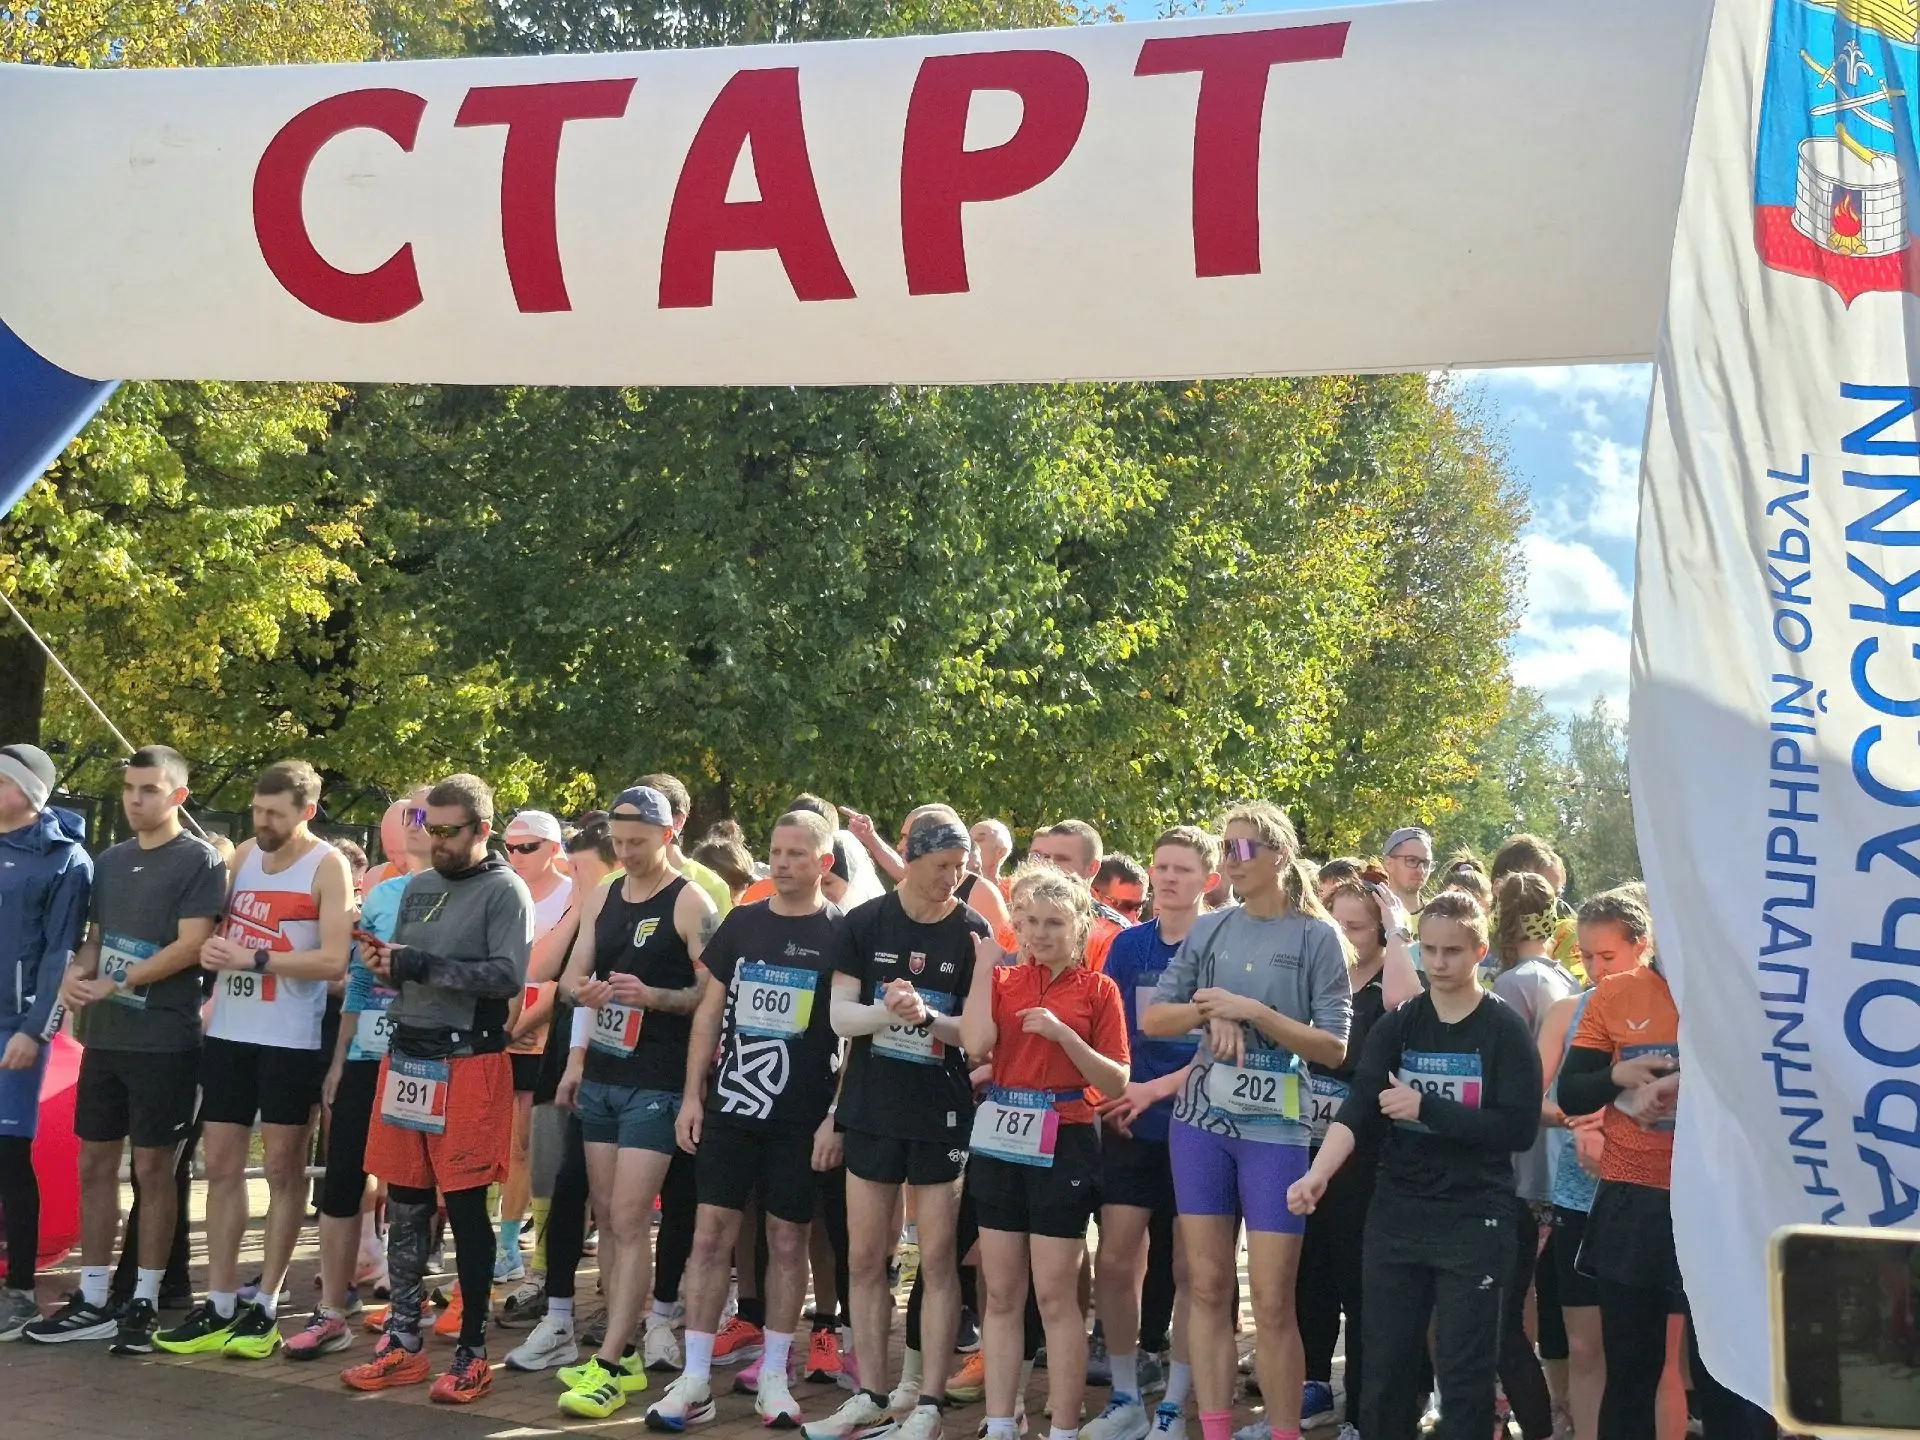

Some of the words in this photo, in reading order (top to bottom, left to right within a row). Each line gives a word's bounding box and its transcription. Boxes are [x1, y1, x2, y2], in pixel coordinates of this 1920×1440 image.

[253, 21, 1351, 324] СТАРТ
[234, 892, 256, 916] 42
[251, 901, 272, 922] КМ
[227, 974, 255, 998] 199
[752, 987, 791, 1015] 660
[596, 1005, 624, 1033] 632
[396, 1080, 428, 1107] 291
[1232, 1073, 1277, 1103] 202
[996, 1108, 1036, 1137] 787
